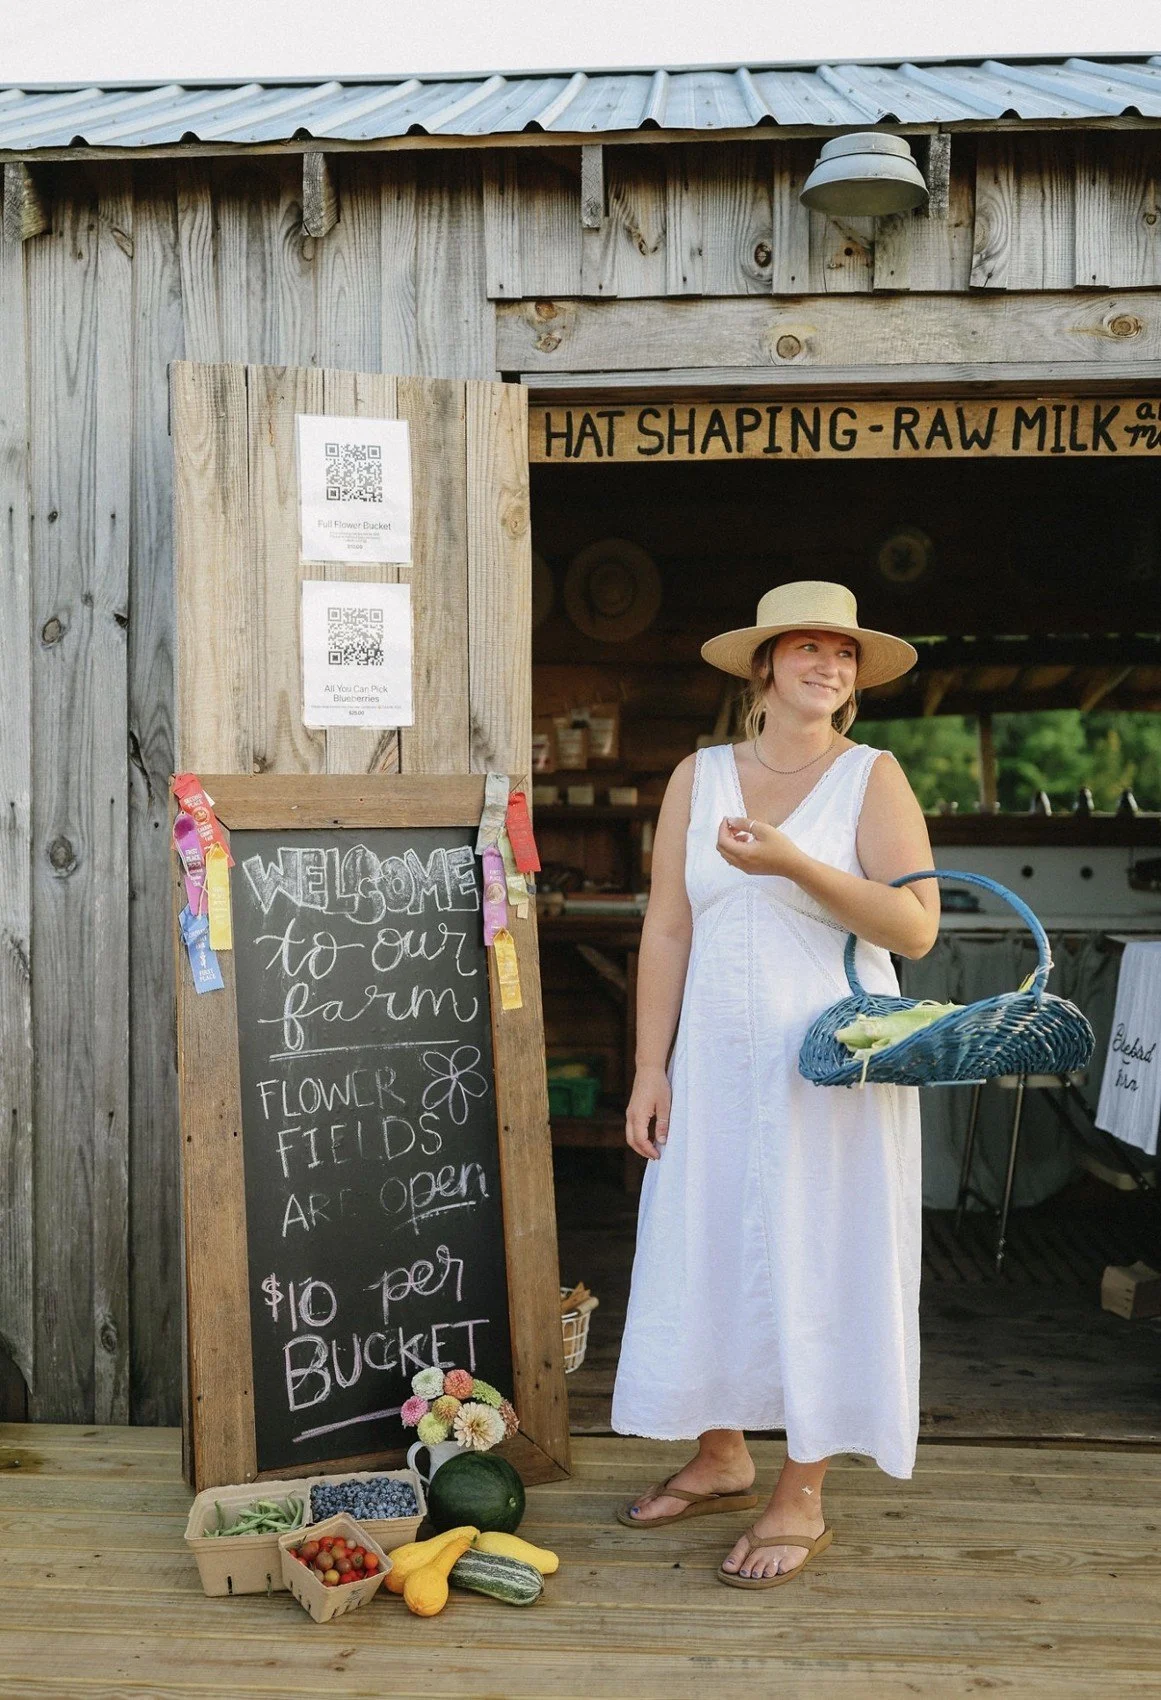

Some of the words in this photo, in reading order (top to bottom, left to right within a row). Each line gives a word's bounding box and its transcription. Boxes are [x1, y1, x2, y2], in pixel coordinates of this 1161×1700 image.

[545, 410, 625, 458] HAT
[636, 406, 858, 455] SHAPING
[892, 406, 998, 451] RAW
[1011, 404, 1120, 453] MILK
[317, 519, 333, 528] Full
[334, 520, 361, 529] Flower
[363, 521, 391, 530] Bucket
[324, 684, 335, 692] All
[337, 684, 352, 693] You
[353, 685, 369, 693] Can
[371, 685, 388, 693] Pick
[333, 693, 380, 703] Blueberries
[242, 843, 480, 925] WELCOME
[253, 918, 366, 980] to
[371, 922, 478, 977] our
[257, 982, 478, 1051] farm
[256, 1066, 406, 1120] FLOWER
[275, 1112, 443, 1178] FIELDS
[261, 1271, 338, 1332] $10
[363, 1245, 464, 1325] per
[283, 1319, 490, 1412] BUCKET
